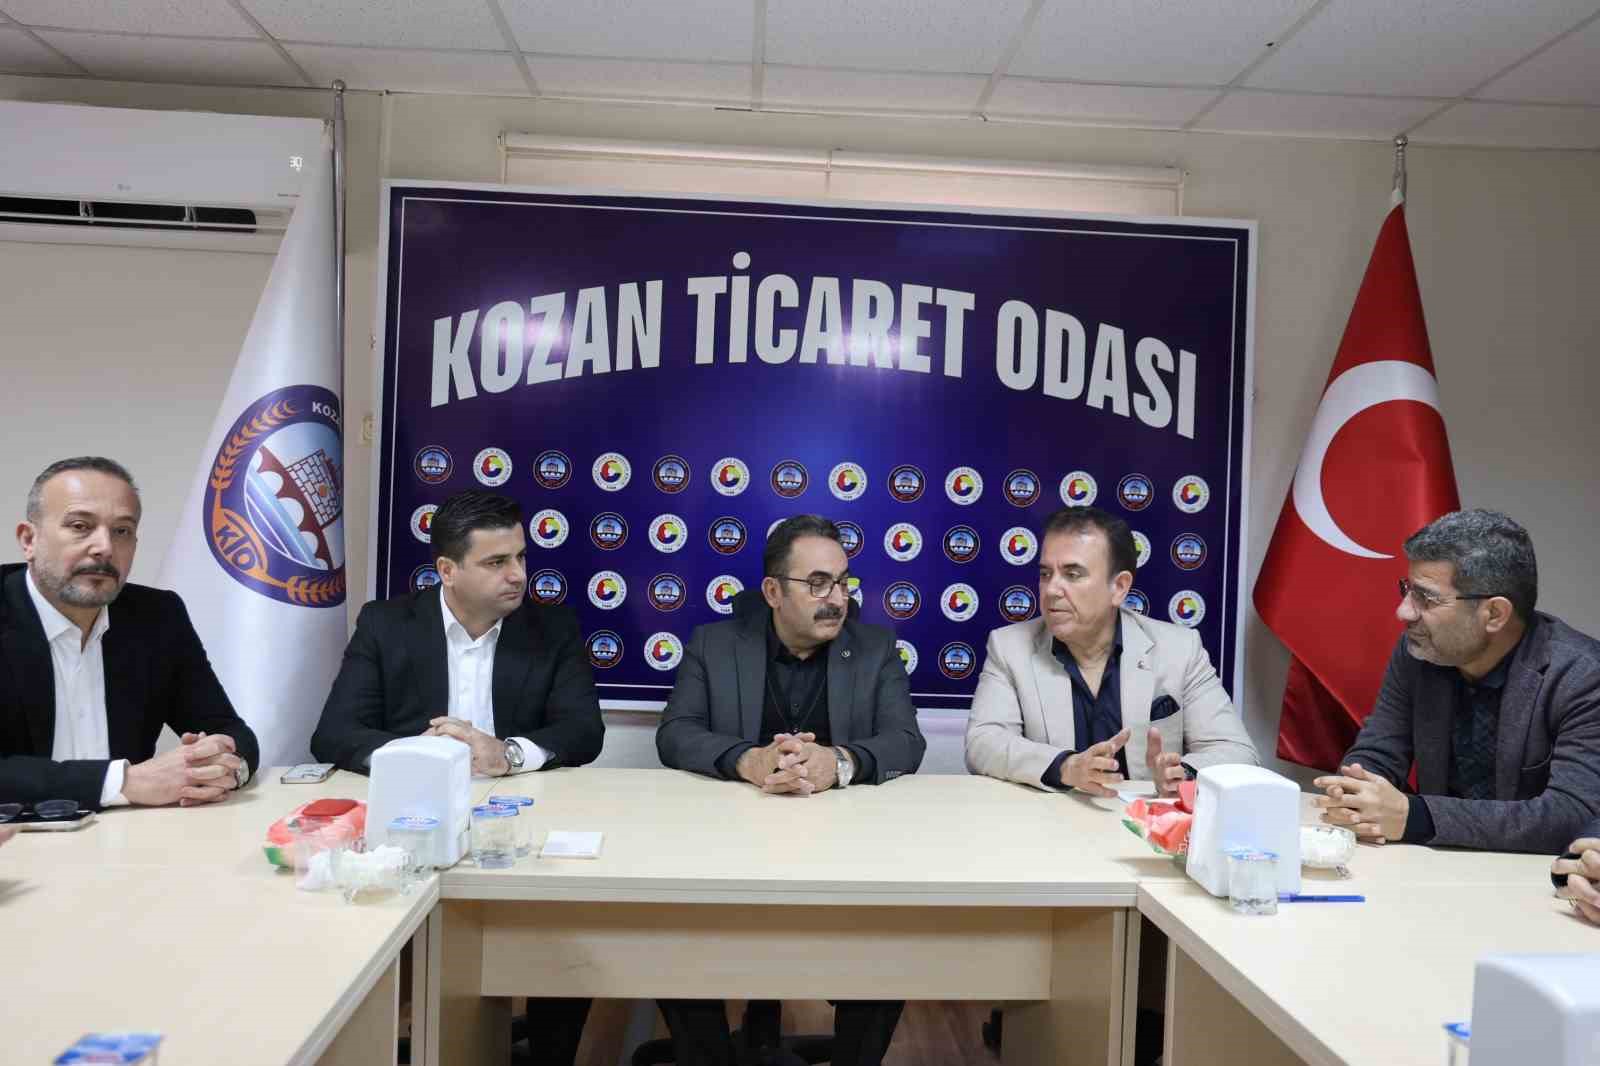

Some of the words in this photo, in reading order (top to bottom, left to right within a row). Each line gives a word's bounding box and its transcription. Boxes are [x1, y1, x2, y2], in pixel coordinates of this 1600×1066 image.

[430, 279, 663, 408] KOZAN
[687, 251, 976, 378] TİCARET
[995, 300, 1197, 440] ODASI
[216, 524, 256, 571] KTO
